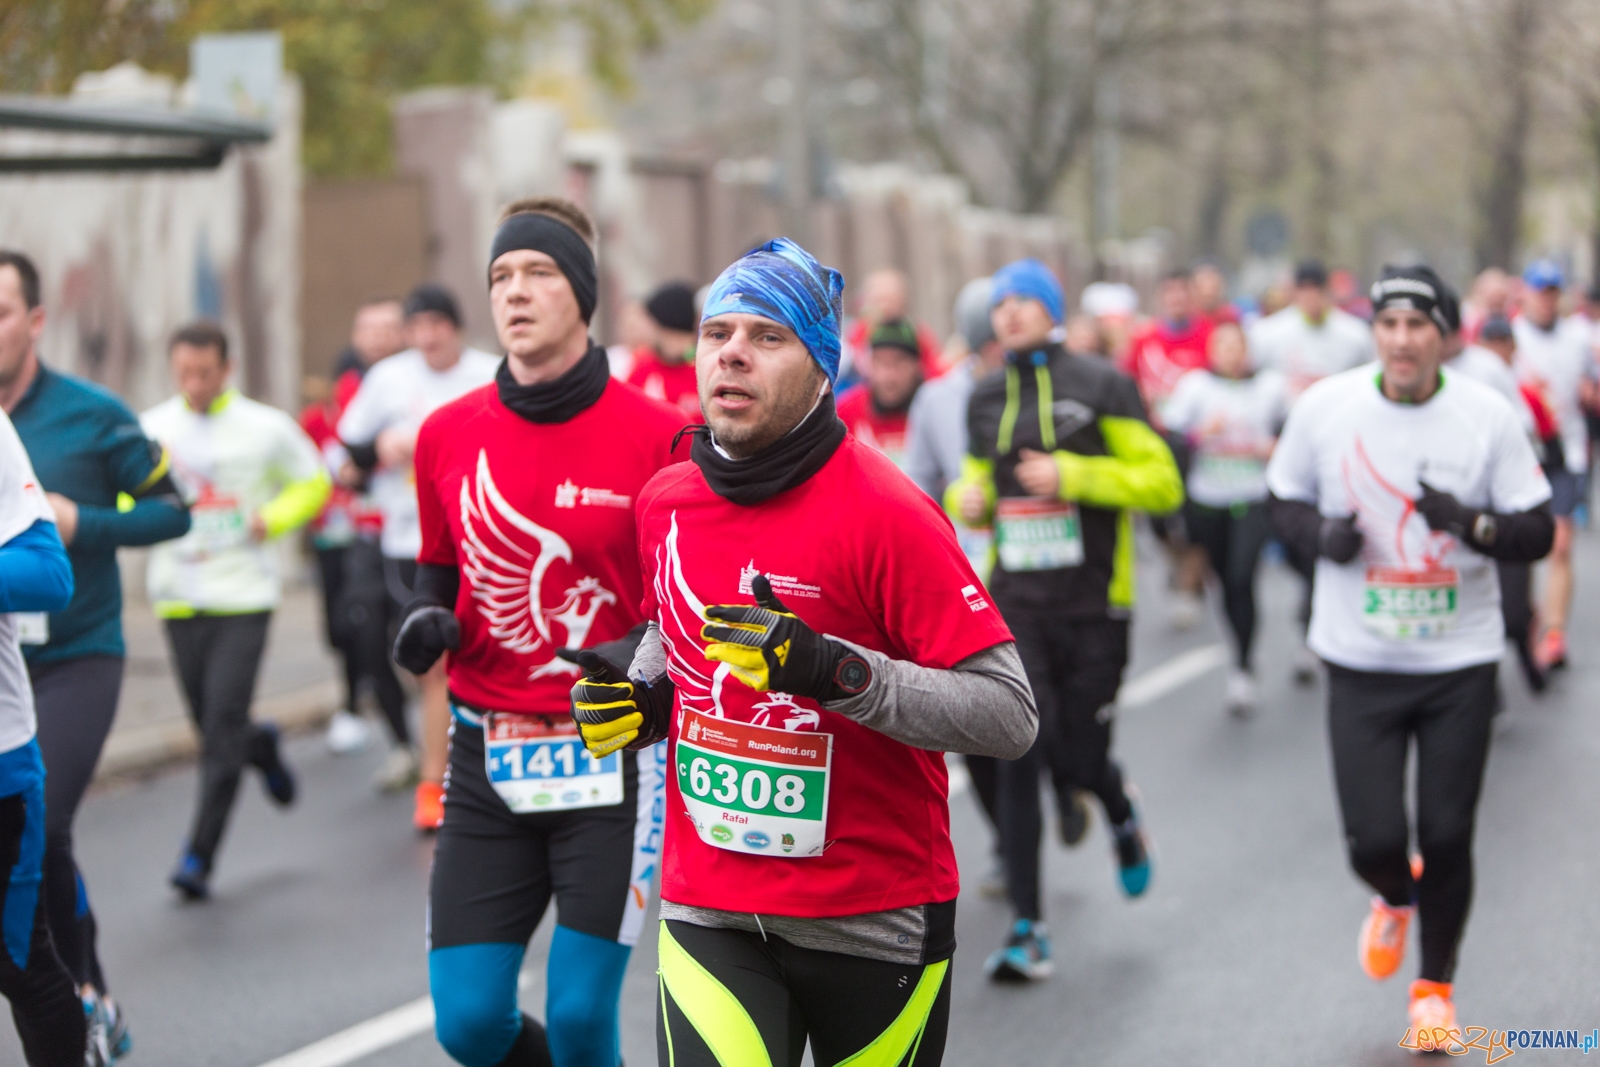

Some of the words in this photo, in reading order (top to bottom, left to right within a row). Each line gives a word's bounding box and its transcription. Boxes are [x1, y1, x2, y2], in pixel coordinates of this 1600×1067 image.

[502, 742, 602, 779] 1411
[748, 739, 817, 759] RunPoland.org
[689, 756, 806, 814] 6308
[722, 811, 749, 825] Rafał
